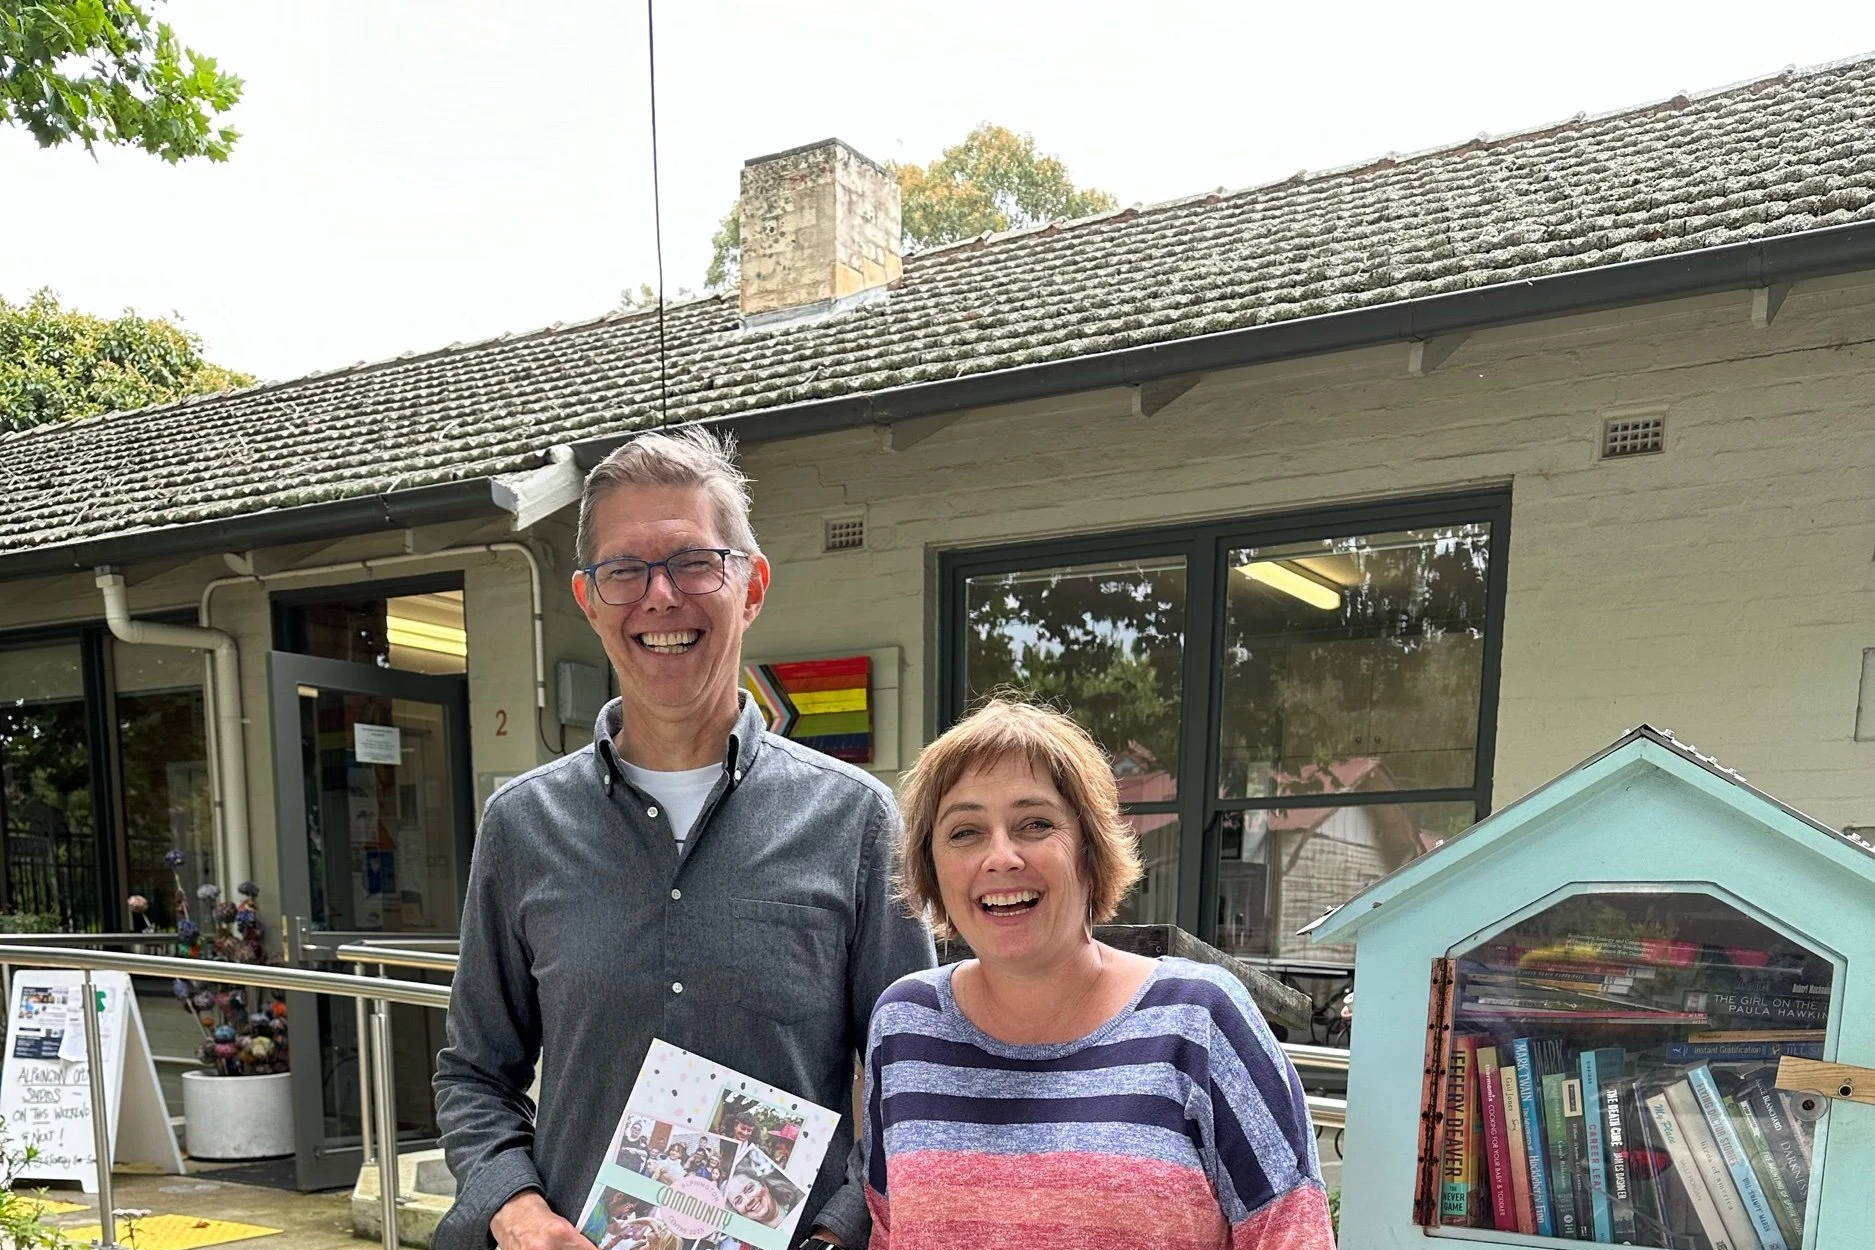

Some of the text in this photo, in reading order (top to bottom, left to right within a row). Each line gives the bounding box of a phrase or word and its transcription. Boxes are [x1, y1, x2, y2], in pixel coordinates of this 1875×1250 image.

[496, 709, 507, 736] 2
[1715, 995, 1736, 1005] THE
[1741, 996, 1768, 1007] GIRL
[1772, 999, 1791, 1008] ON
[1796, 1001, 1818, 1010] THE
[1729, 1005, 1828, 1019] PAULA HAWKIN
[1694, 1045, 1761, 1054] Instant Gratification
[1485, 1063, 1495, 1102] thermomix
[1514, 1041, 1532, 1101] MARK TWAIN
[1505, 1076, 1514, 1111] Gail Jones
[12, 1102, 90, 1122] ON THIS WEEKEND
[1445, 1050, 1466, 1177] JEFFERY DEAVER
[1488, 1104, 1498, 1135] COOKING
[1606, 1089, 1623, 1146] THE DEATH CURE
[1652, 1103, 1676, 1145] My Place
[1695, 1083, 1739, 1167] FLYING DOCTOR STORIES
[1762, 1095, 1782, 1132] BLANCHARD
[1491, 1136, 1499, 1148] FOR
[1588, 1123, 1599, 1163] CAREER
[1493, 1149, 1501, 1166] YOUR
[1761, 1150, 1772, 1164] THE
[1495, 1167, 1503, 1182] BABY
[1612, 1151, 1627, 1199] JAMES DASHNER
[1700, 1141, 1733, 1211] birds of america
[1766, 1163, 1784, 1190] HAUNTING
[681, 1180, 720, 1202] ALPHINGTON
[1529, 1154, 1546, 1223] Huckleberry Finn
[1778, 1190, 1787, 1199] OF
[656, 1185, 733, 1231] COMMUNITY
[1443, 1202, 1464, 1212] GAME
[1498, 1190, 1506, 1216] TODDLER
[1742, 1177, 1751, 1189] BILL
[1757, 1213, 1771, 1232] MARSH
[1782, 1198, 1797, 1218] SPOOK
[669, 1215, 688, 1234] CENTRE
